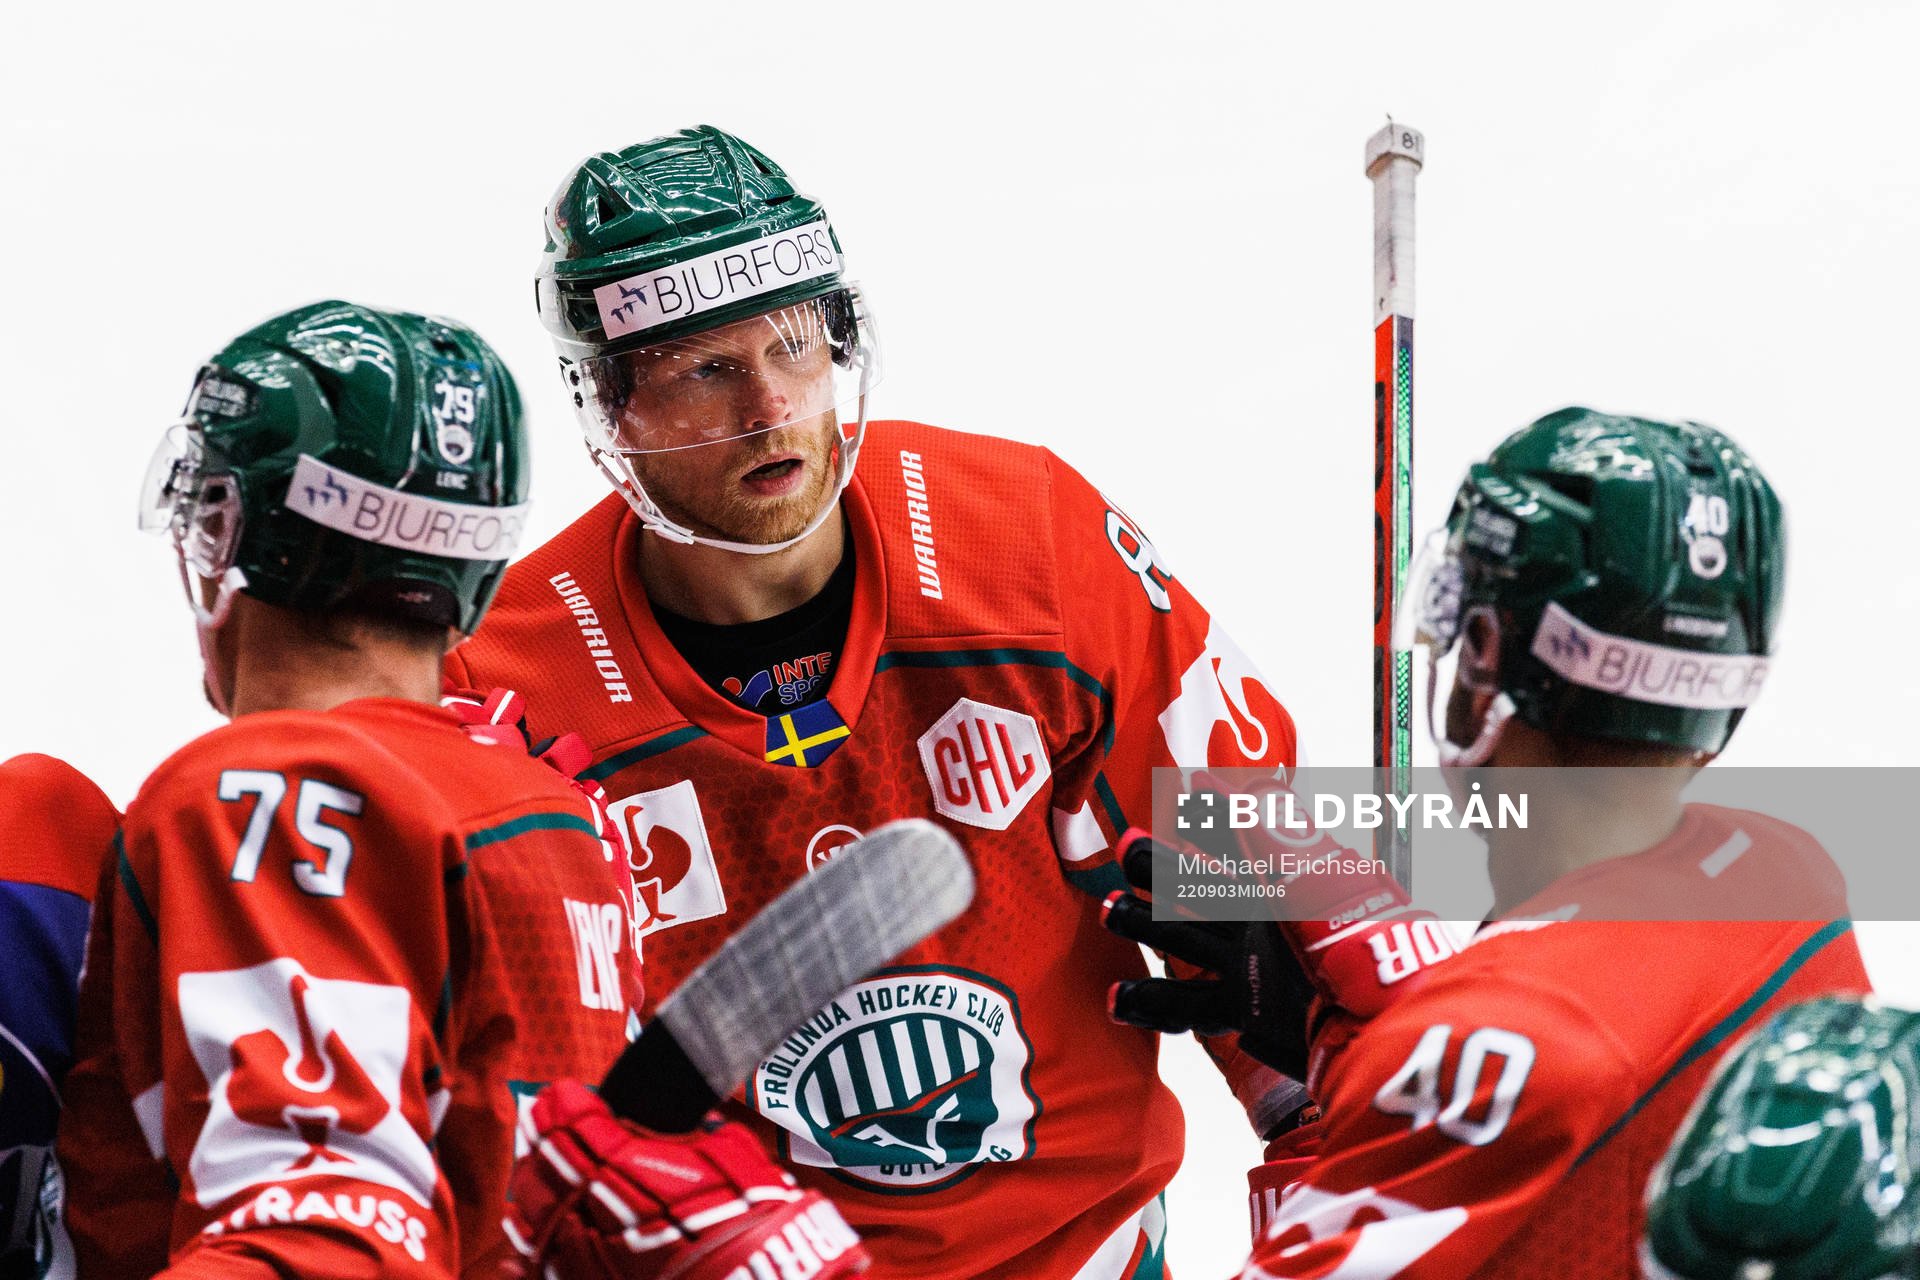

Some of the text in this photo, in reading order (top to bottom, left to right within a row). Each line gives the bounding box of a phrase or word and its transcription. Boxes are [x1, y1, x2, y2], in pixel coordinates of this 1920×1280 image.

[653, 229, 834, 317] BJURFORS
[900, 449, 943, 600] WARRIOR
[548, 571, 633, 704] WARRIOR
[933, 717, 1036, 814] CHL
[217, 768, 366, 898] 75
[760, 983, 1005, 1109] FRÖLUNDA HOCKEY CLUB
[1373, 1024, 1537, 1147] 40
